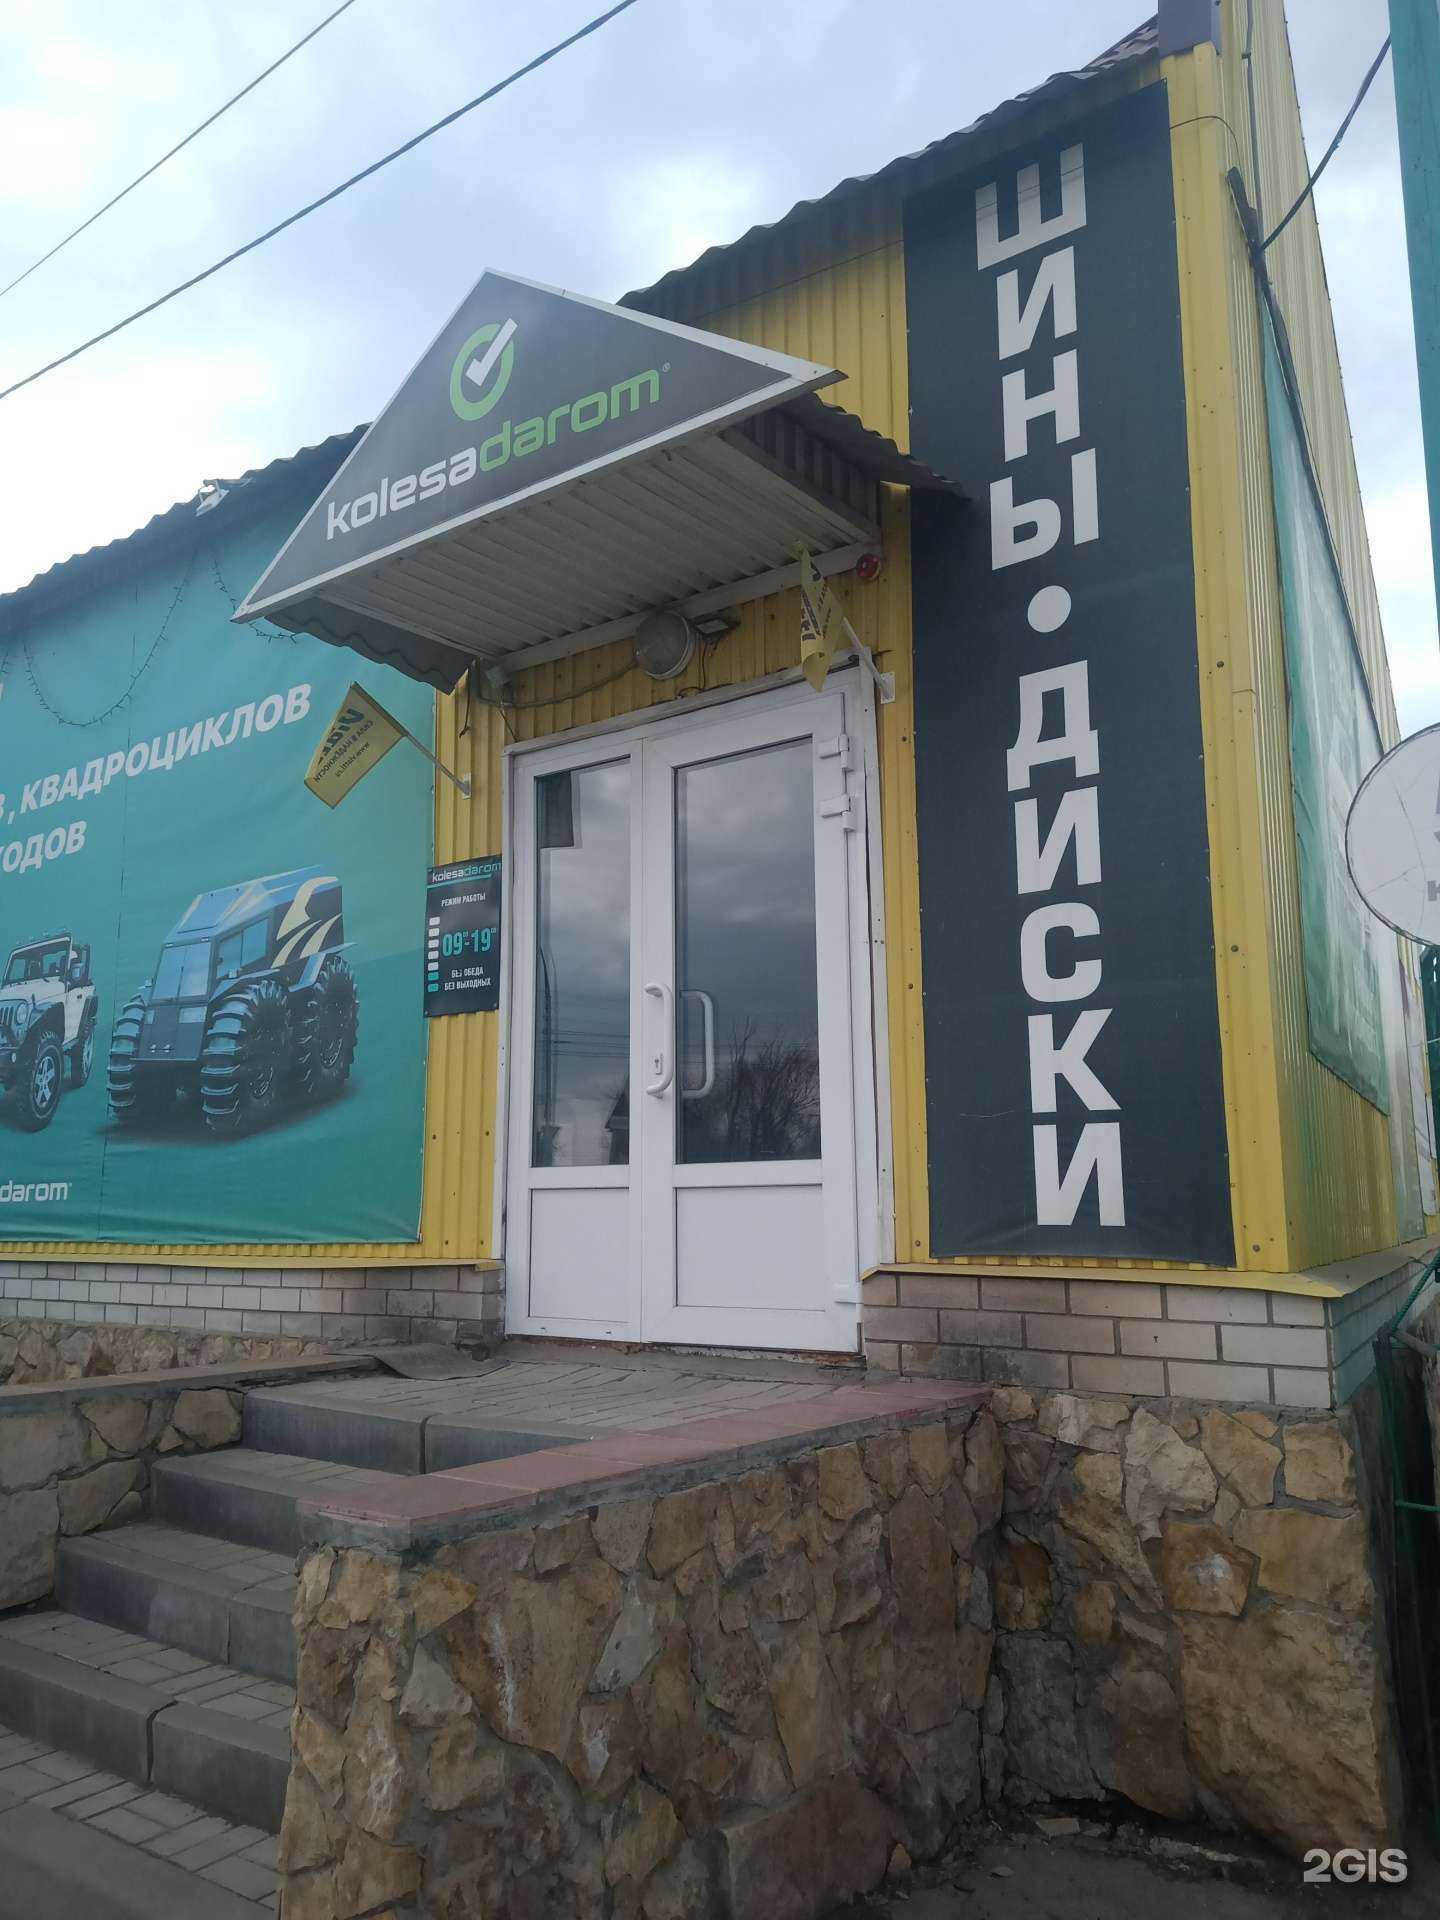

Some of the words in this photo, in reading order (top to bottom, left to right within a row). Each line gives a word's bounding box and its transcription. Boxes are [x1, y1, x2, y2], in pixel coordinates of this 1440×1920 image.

[975, 143, 1099, 570] ШИНЫ
[326, 368, 660, 541] kolesadarom
[20, 684, 312, 814] КВАДРОЦИКЛОВ
[0, 820, 88, 874] ОДОВ
[432, 862, 501, 882] kolesadarom
[441, 896, 461, 907] РЕЖИМ
[462, 892, 486, 904] РАБОТЫ
[1006, 660, 1125, 1226] ДИСКИ
[444, 982, 455, 991] БЕЗ
[456, 977, 491, 990] ВЫХОДНЫХ
[464, 966, 484, 977] ОБЕДА
